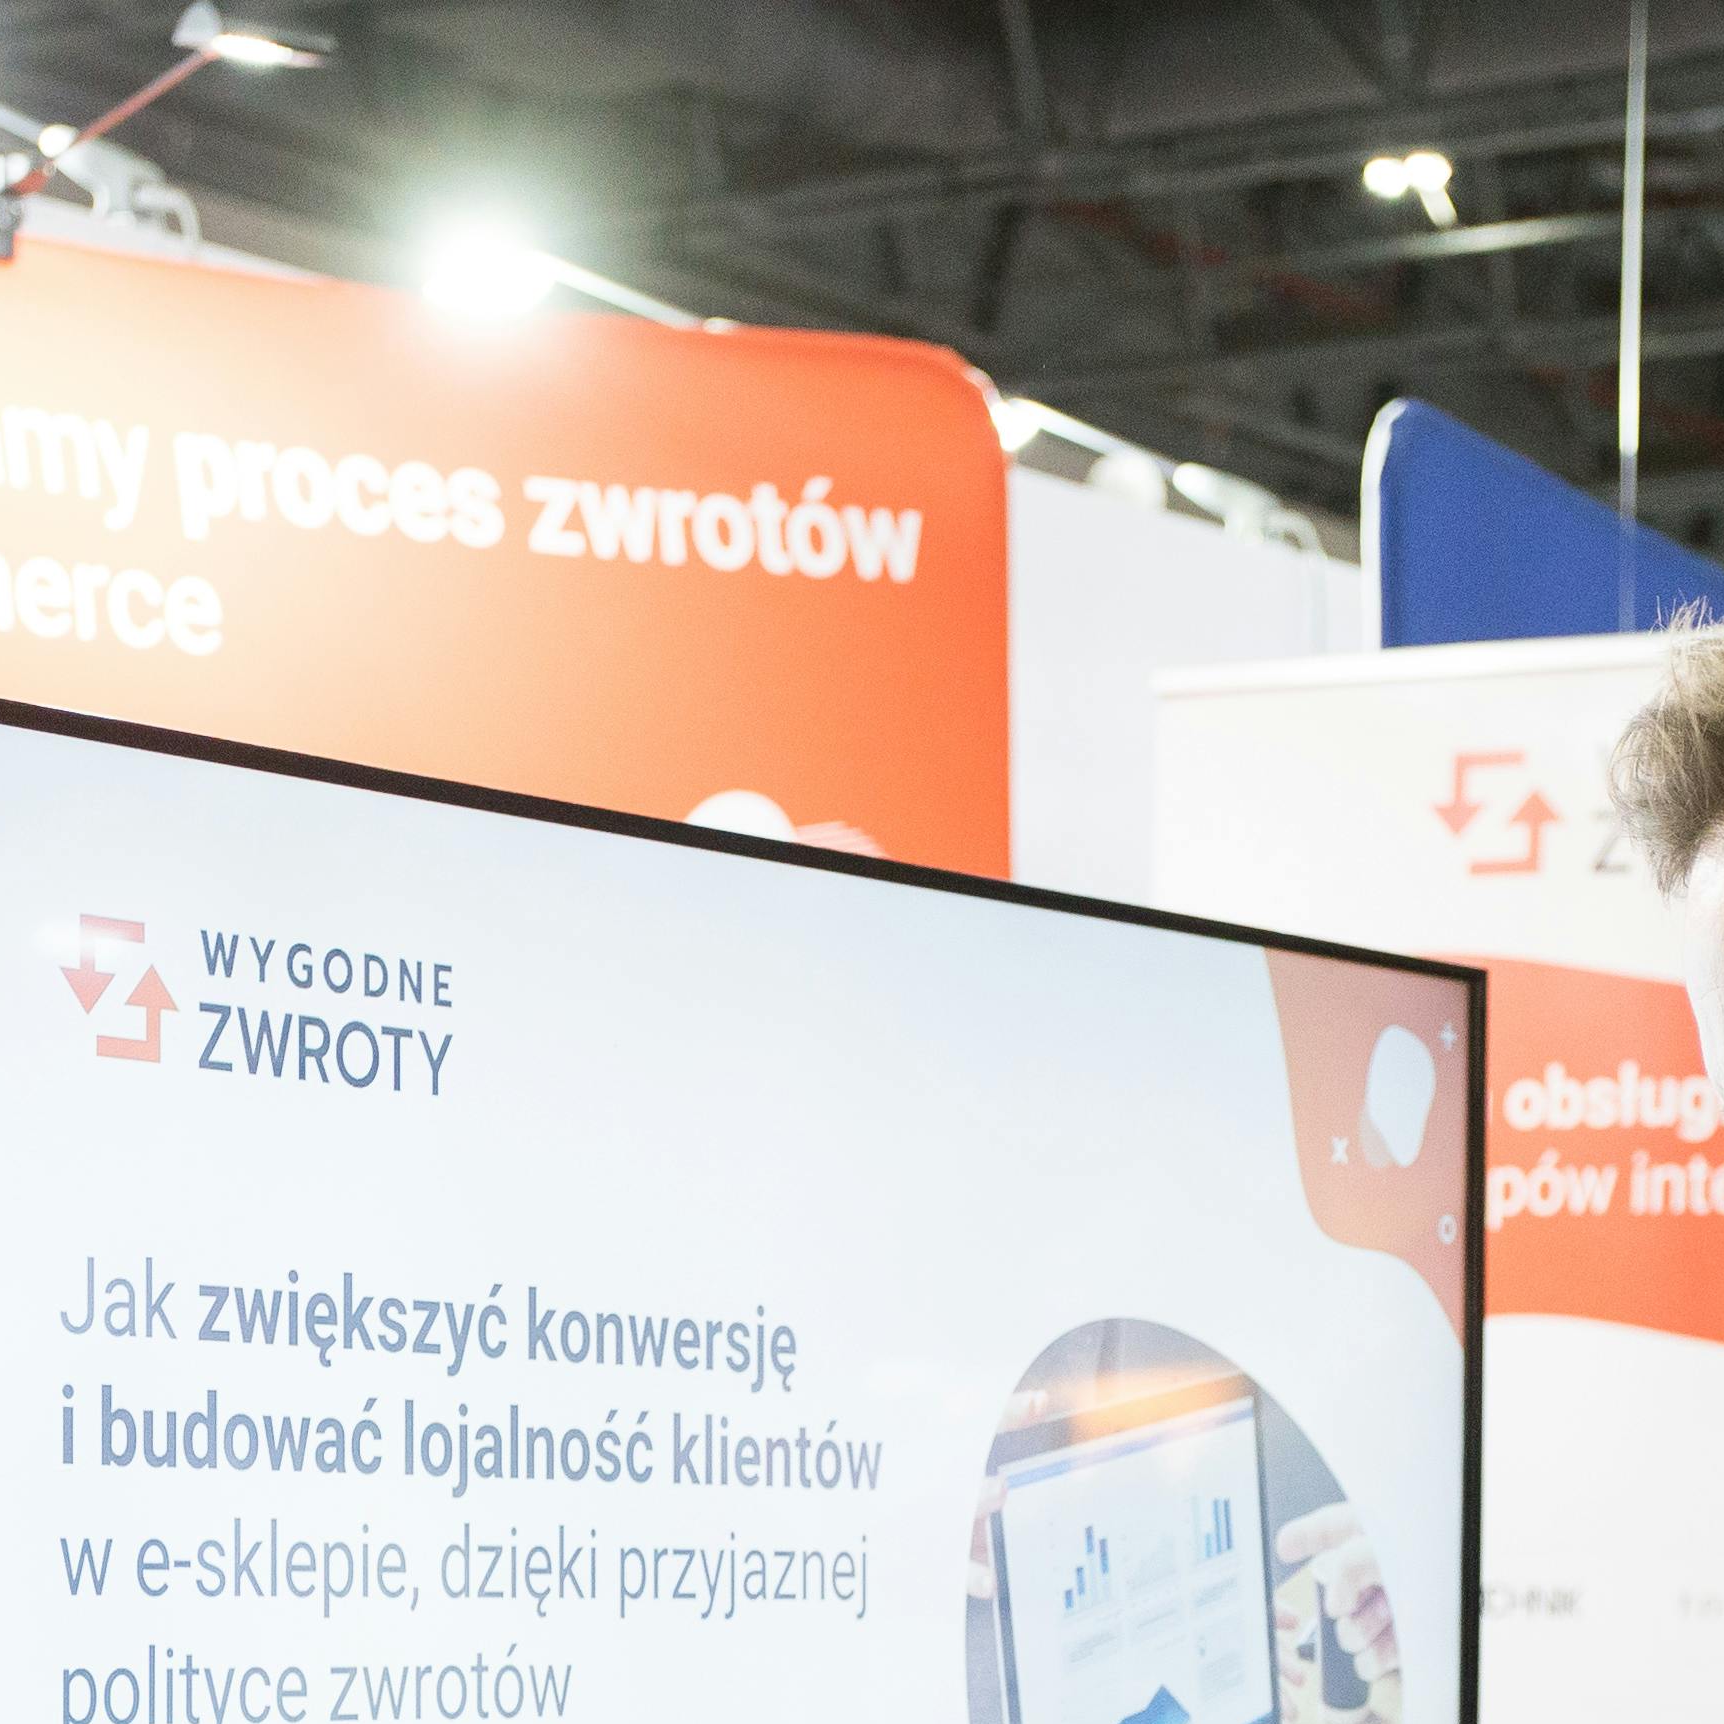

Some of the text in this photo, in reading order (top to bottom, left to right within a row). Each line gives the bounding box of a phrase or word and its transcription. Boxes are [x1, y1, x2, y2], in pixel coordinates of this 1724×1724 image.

[173, 430, 506, 547] proces
[523, 475, 923, 584] zwrotów
[199, 928, 454, 1009] WYGODNE
[198, 1001, 454, 1097] ZWROTY
[60, 1256, 798, 1394] Jak zwiększyć konwersję
[61, 1384, 884, 1499] i budować lojalność klientów
[60, 1516, 870, 1620] w e-sklepie, dzięki przyjaznej
[328, 1643, 573, 1723] zwrotów
